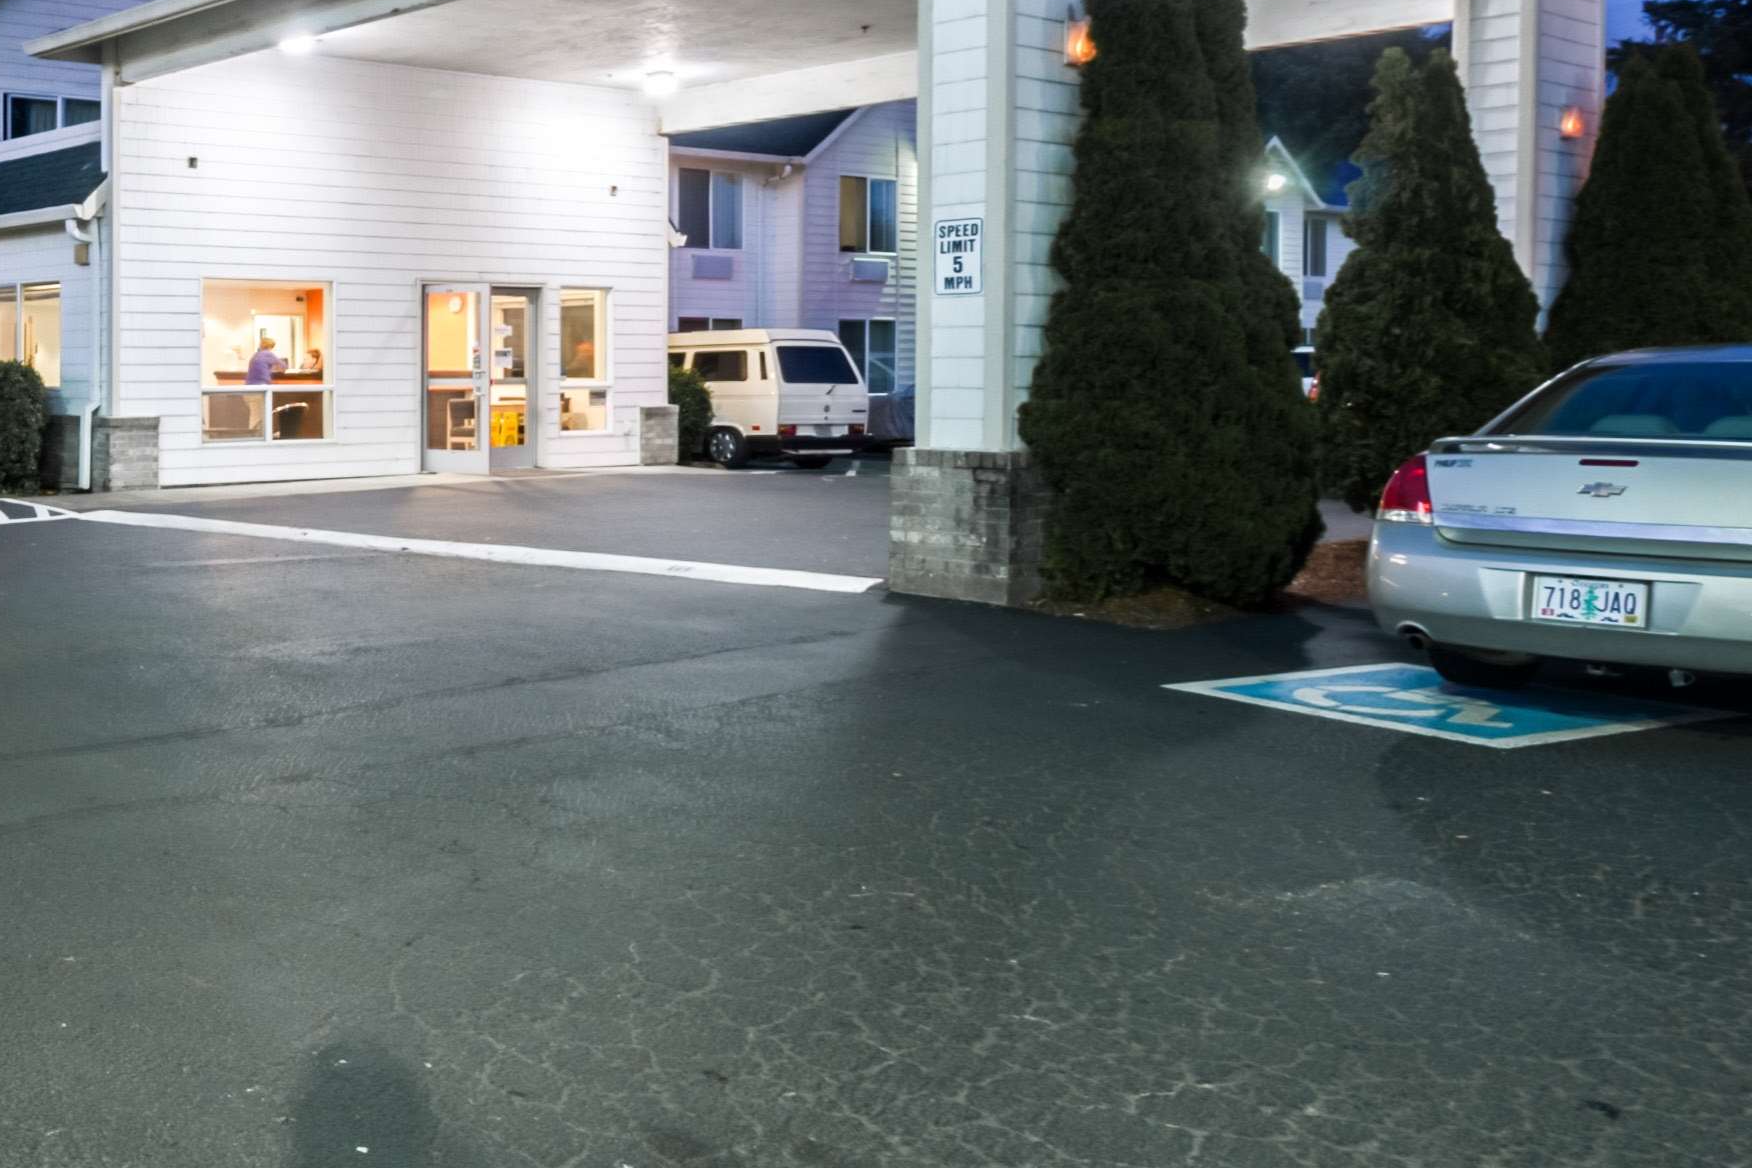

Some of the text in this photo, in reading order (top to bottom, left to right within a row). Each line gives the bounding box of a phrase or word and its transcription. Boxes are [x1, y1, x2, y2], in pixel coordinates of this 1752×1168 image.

[938, 223, 979, 239] SPEED
[939, 239, 976, 254] LIMIT
[952, 256, 963, 273] 5
[944, 276, 973, 290] MPH
[1543, 586, 1582, 610] 718
